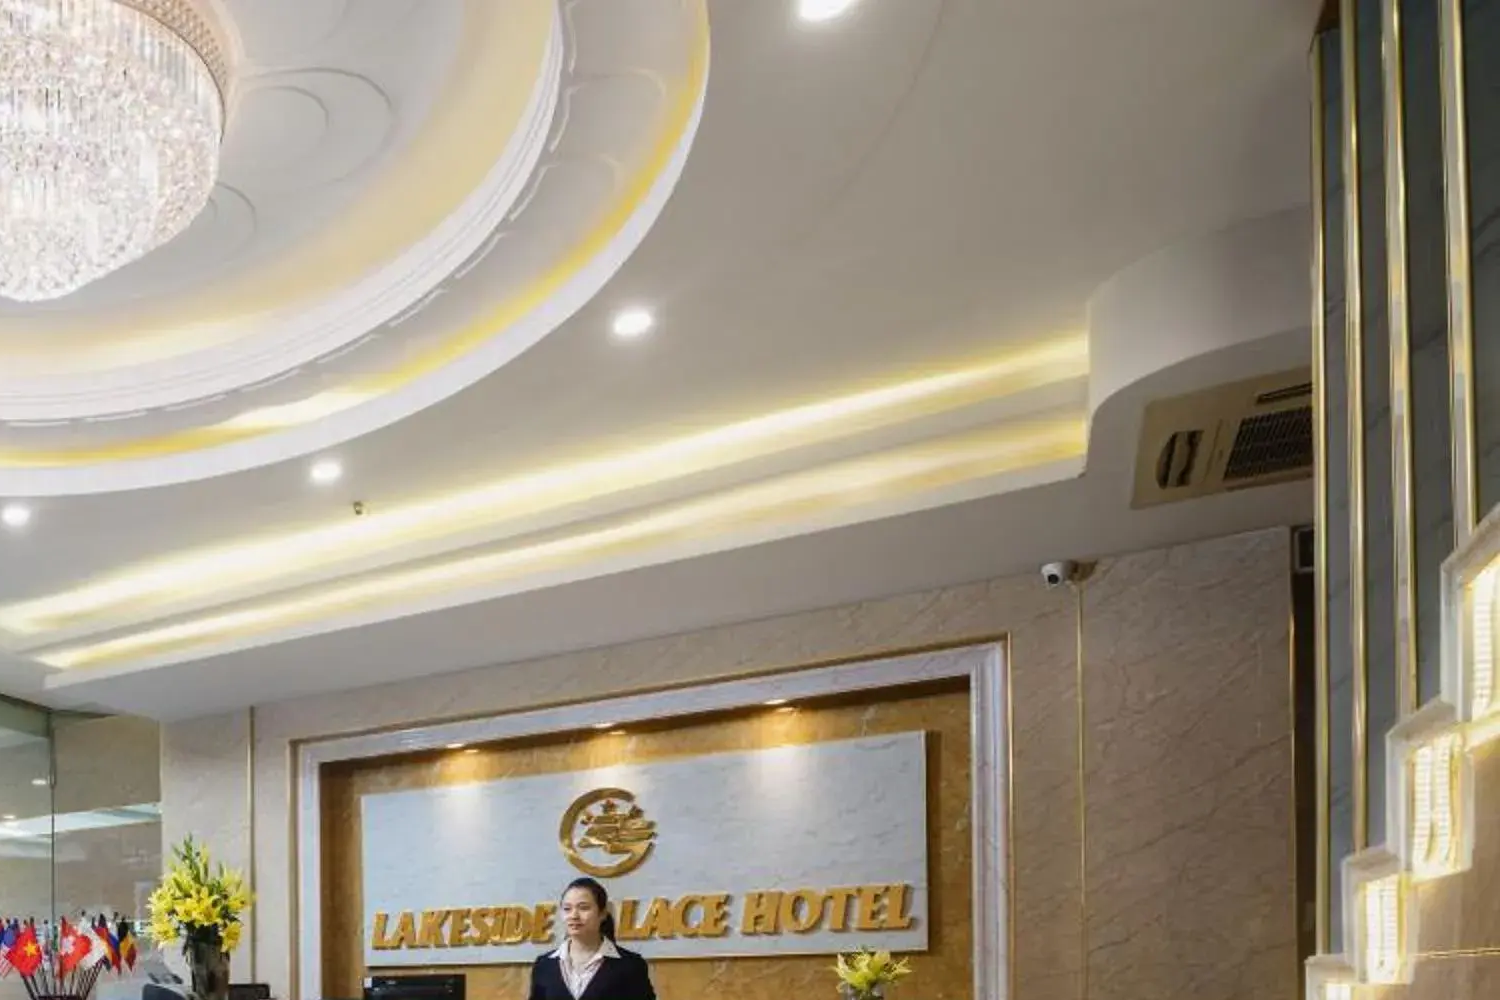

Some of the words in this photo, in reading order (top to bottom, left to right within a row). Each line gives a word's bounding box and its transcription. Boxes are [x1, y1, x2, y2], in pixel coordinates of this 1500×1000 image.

[371, 902, 557, 950] LAKESIDE
[617, 892, 732, 941] LACE
[740, 883, 916, 936] HOTEL
